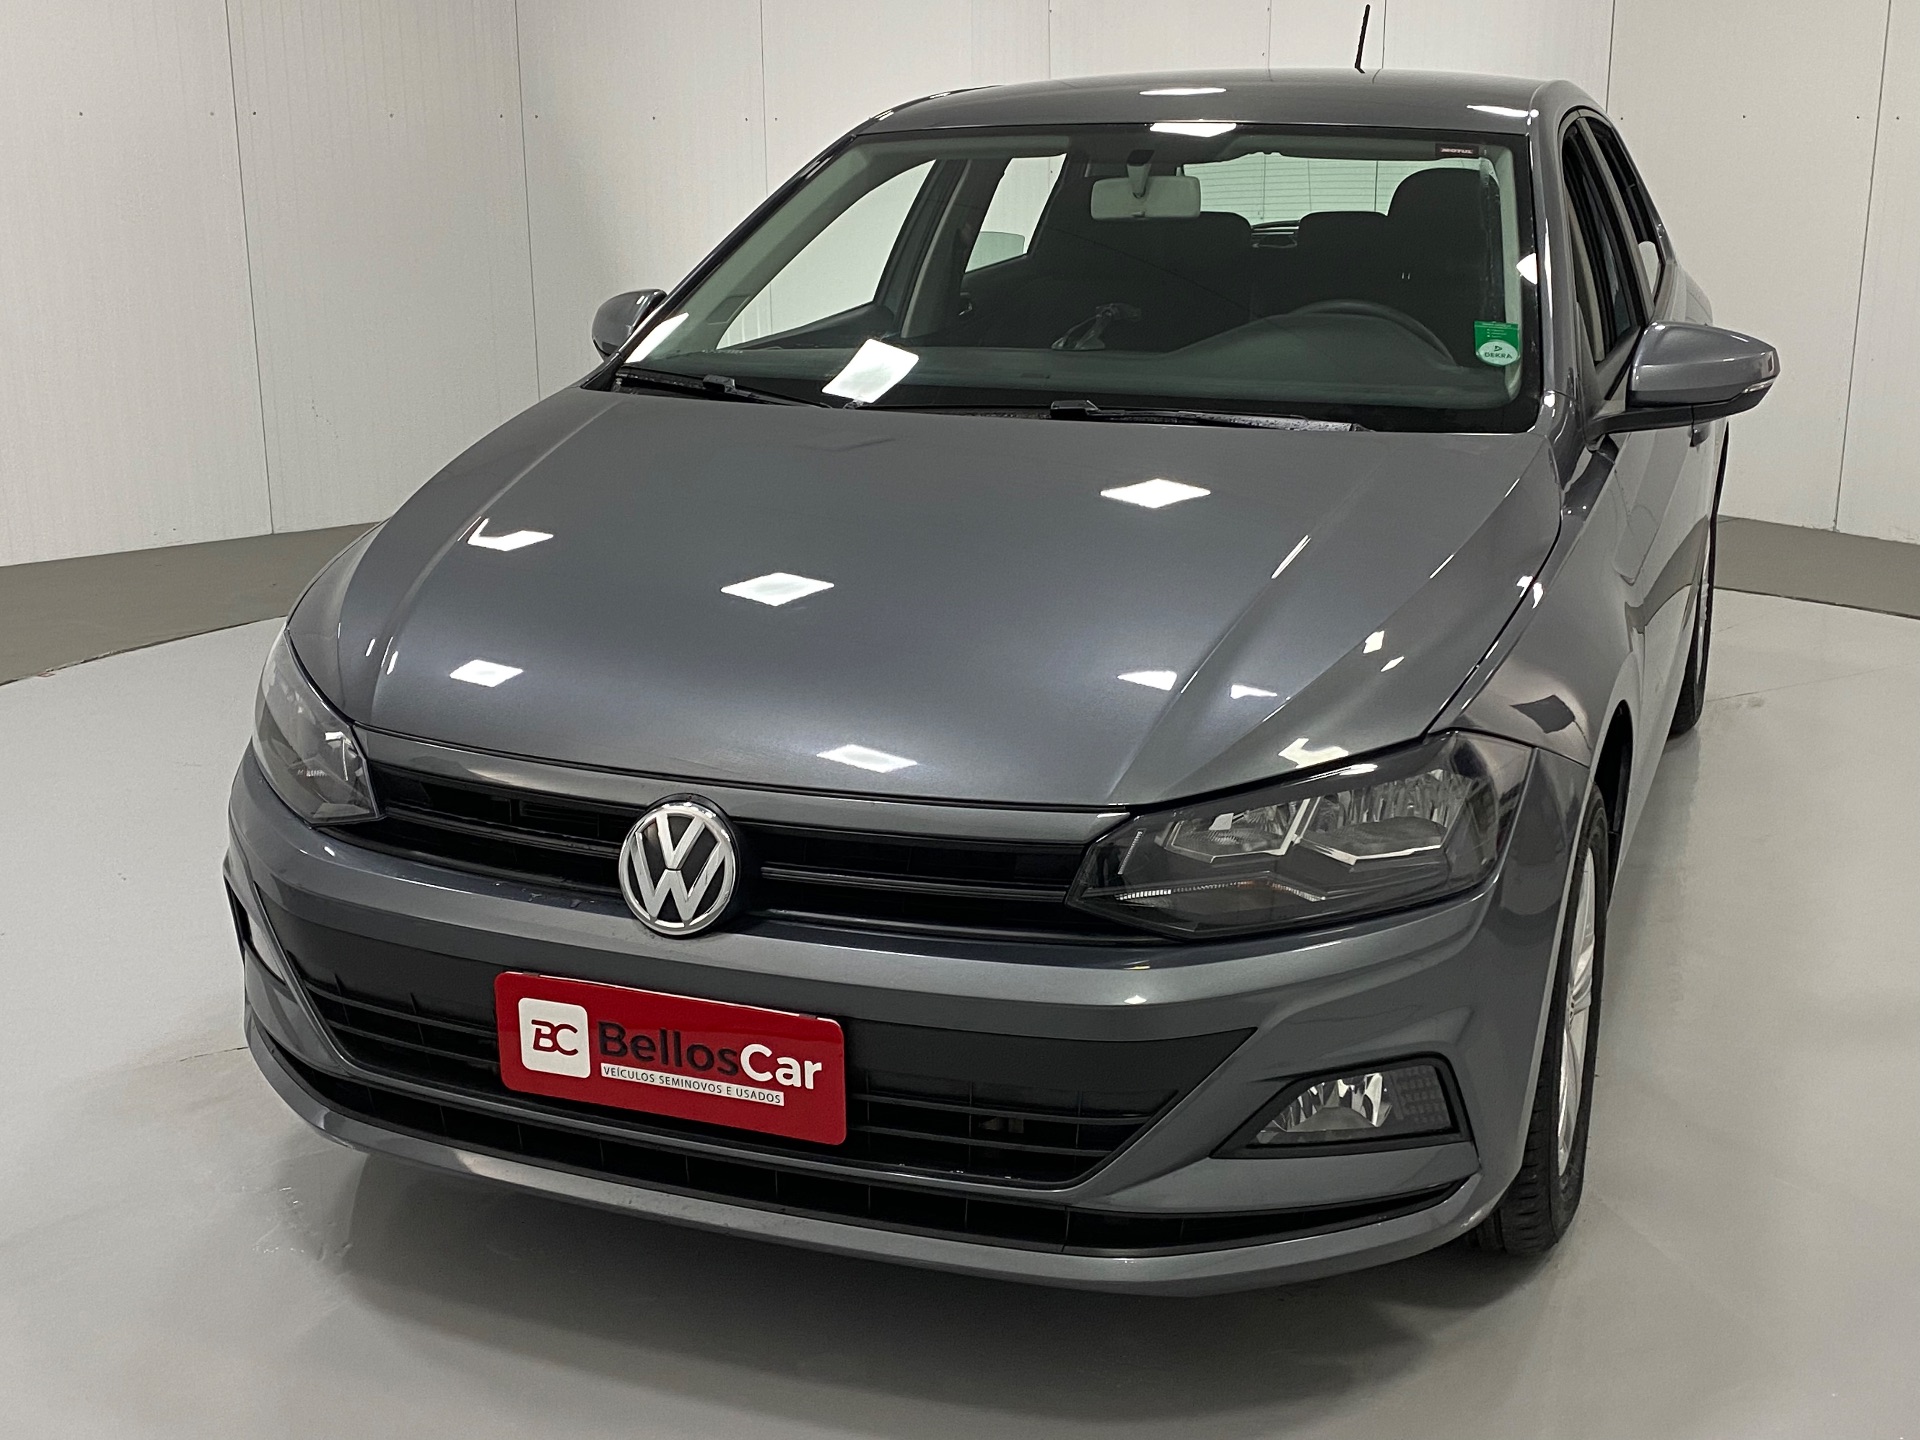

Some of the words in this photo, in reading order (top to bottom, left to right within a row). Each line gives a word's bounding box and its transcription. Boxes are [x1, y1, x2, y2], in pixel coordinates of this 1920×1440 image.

[624, 808, 729, 925] VW
[531, 1018, 579, 1057] BC
[597, 1021, 822, 1090] BellosCar
[603, 1065, 655, 1083] VEÍCULOS
[658, 1075, 722, 1094] SEMINOVOS
[726, 1086, 732, 1096] E
[735, 1088, 781, 1104] USADOS
